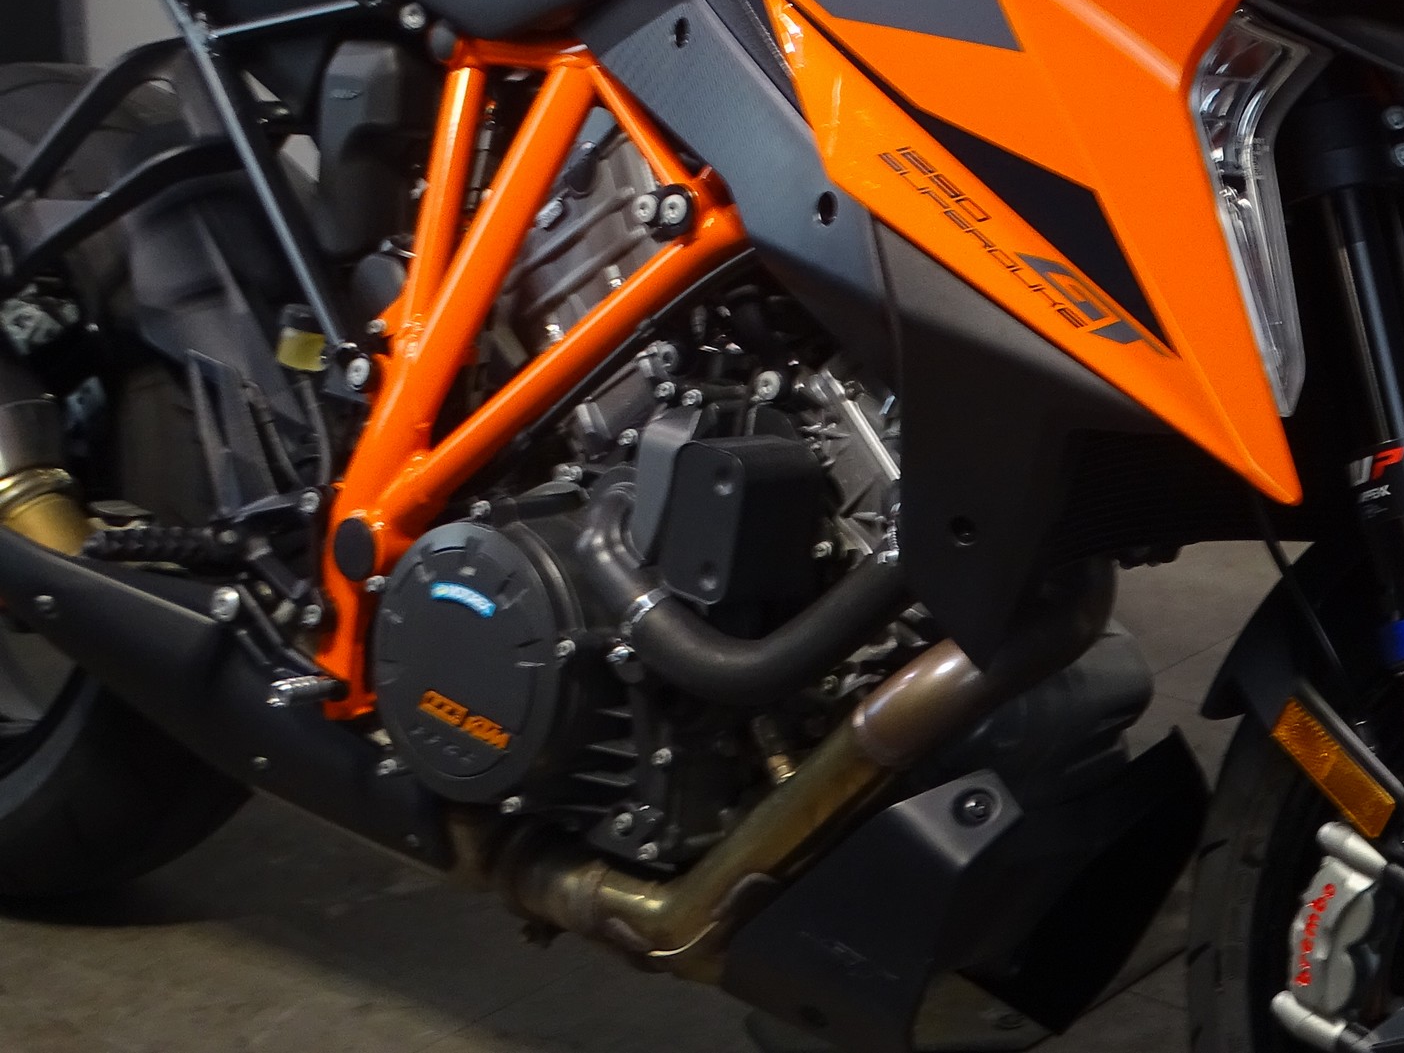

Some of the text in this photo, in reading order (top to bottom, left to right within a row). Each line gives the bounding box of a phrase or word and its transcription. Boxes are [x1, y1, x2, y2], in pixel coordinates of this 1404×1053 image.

[896, 146, 992, 222] 1290
[878, 151, 1090, 330] SUPERDUKE
[1014, 251, 1176, 358] GT
